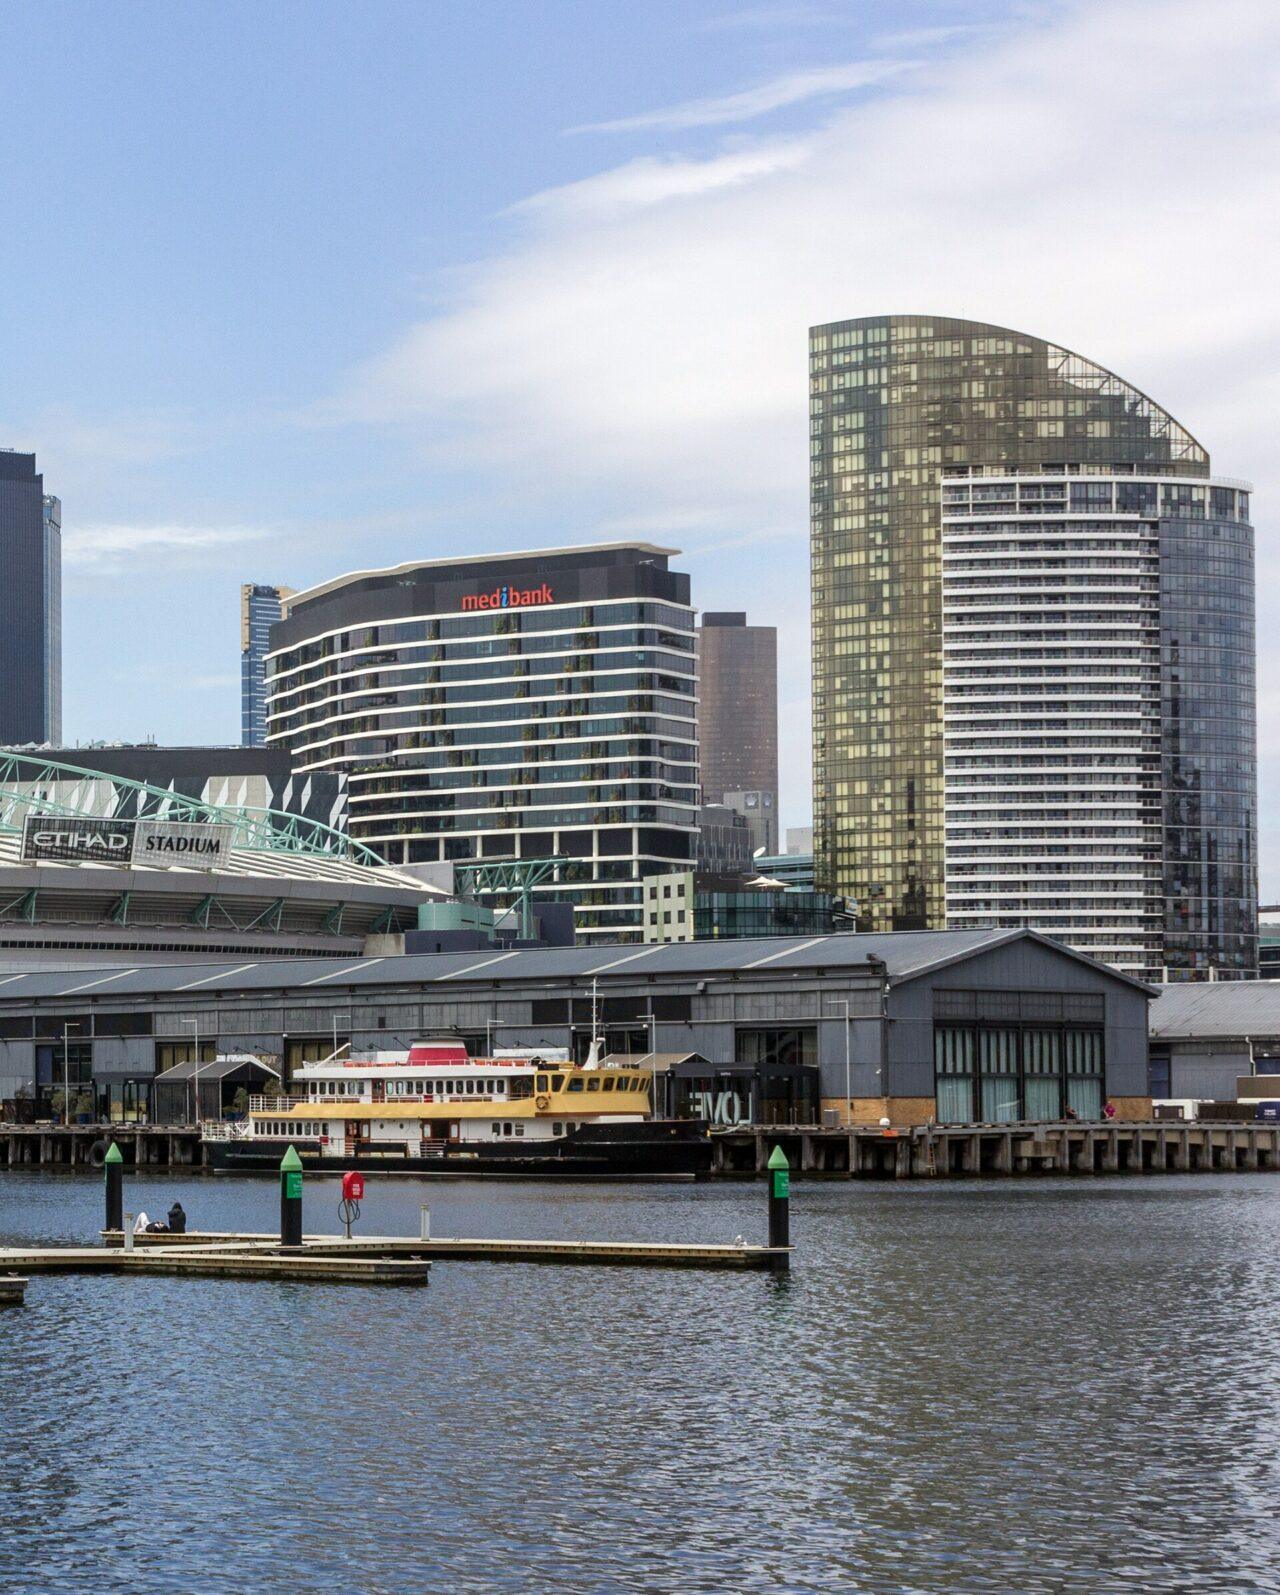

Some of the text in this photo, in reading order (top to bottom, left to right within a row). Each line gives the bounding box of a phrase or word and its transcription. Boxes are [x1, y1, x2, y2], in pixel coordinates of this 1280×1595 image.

[462, 583, 554, 610] medibank
[33, 831, 220, 853] ETIHAD STADIUM
